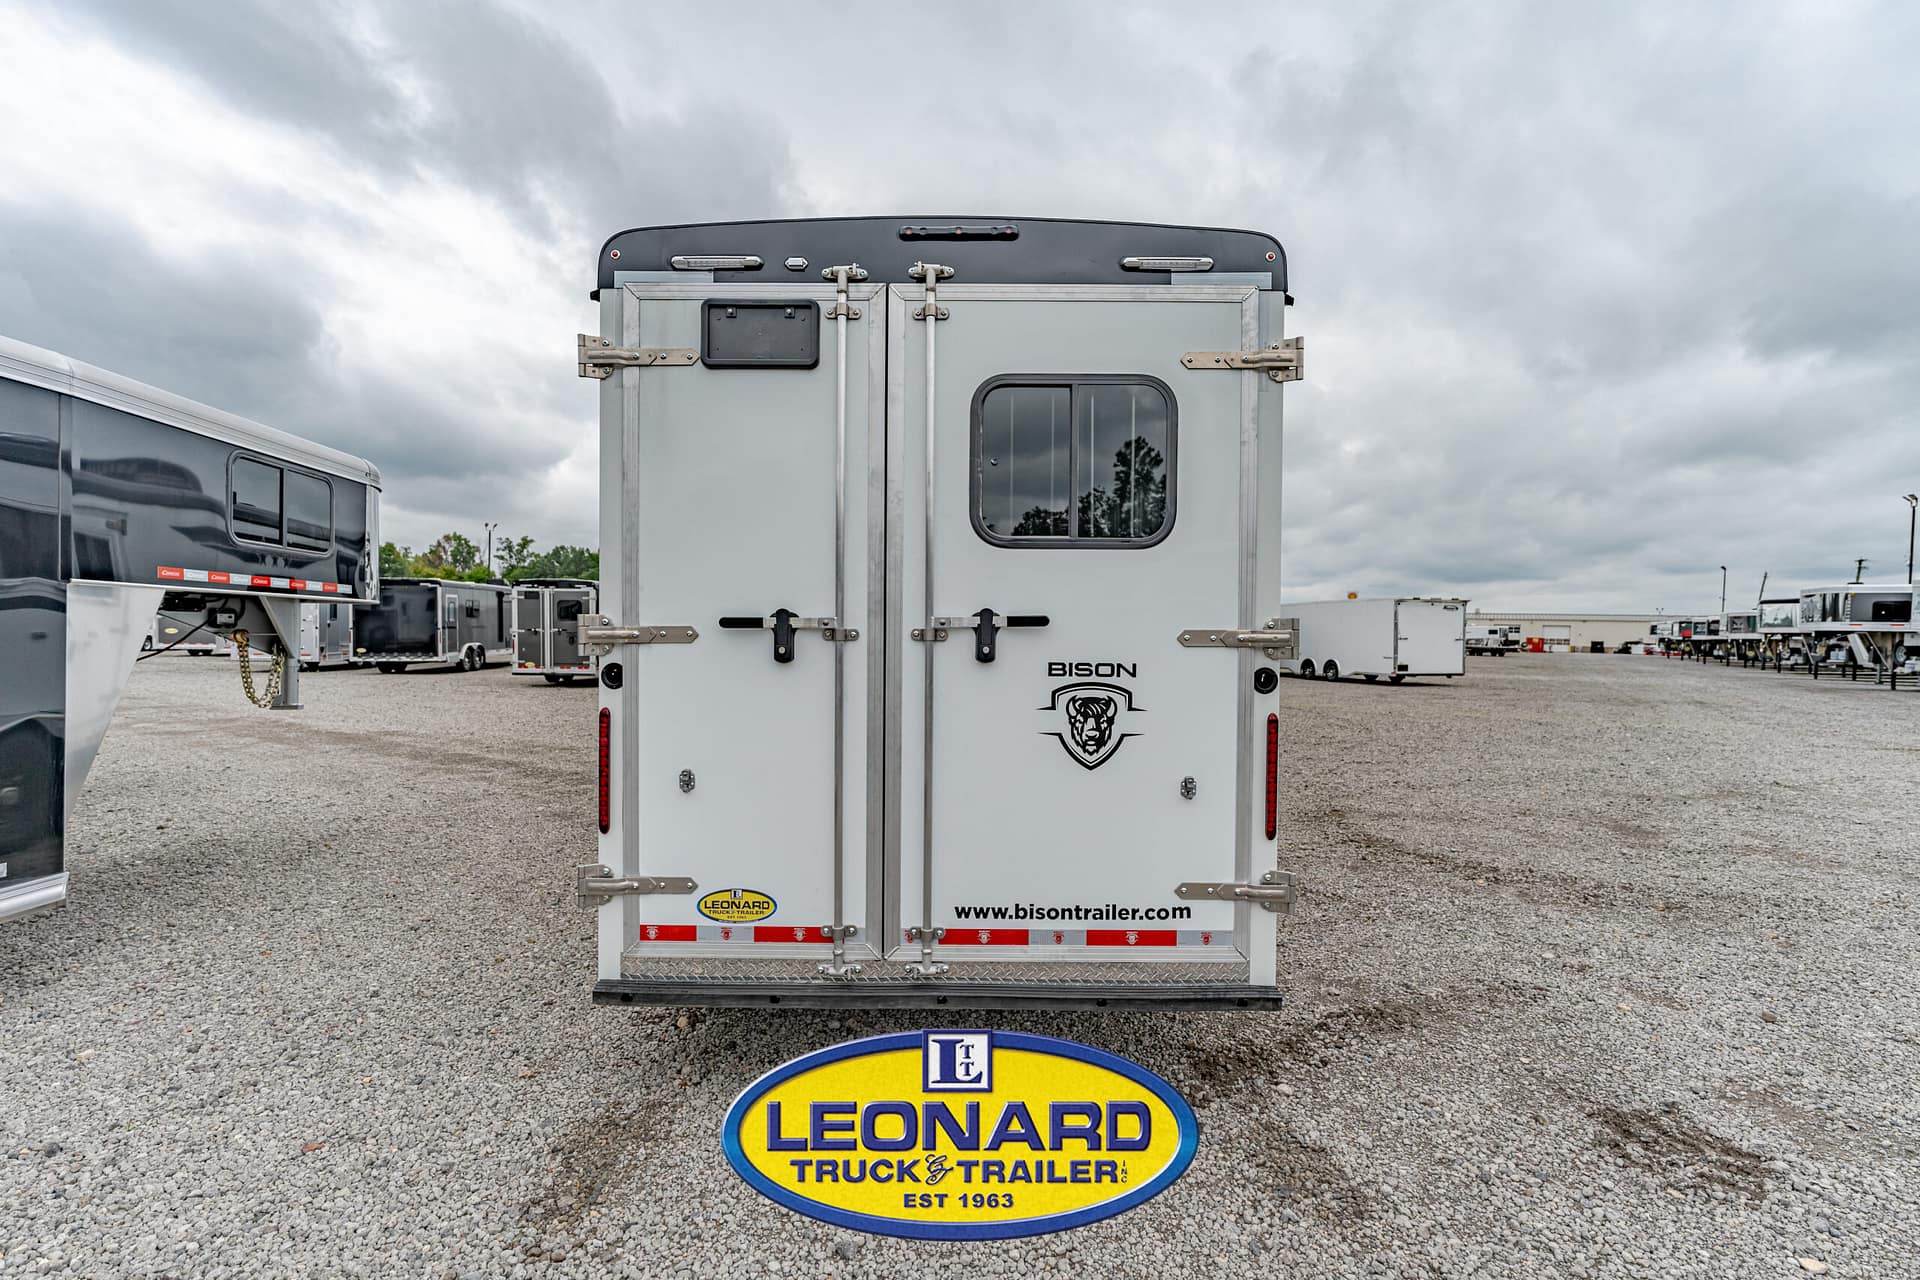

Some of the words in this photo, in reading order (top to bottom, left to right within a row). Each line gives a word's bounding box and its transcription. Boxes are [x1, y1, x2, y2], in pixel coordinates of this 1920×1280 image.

[1048, 662, 1137, 678] BISON
[704, 900, 770, 910] LEONARD
[954, 903, 1192, 921] www.bisontrailer.com
